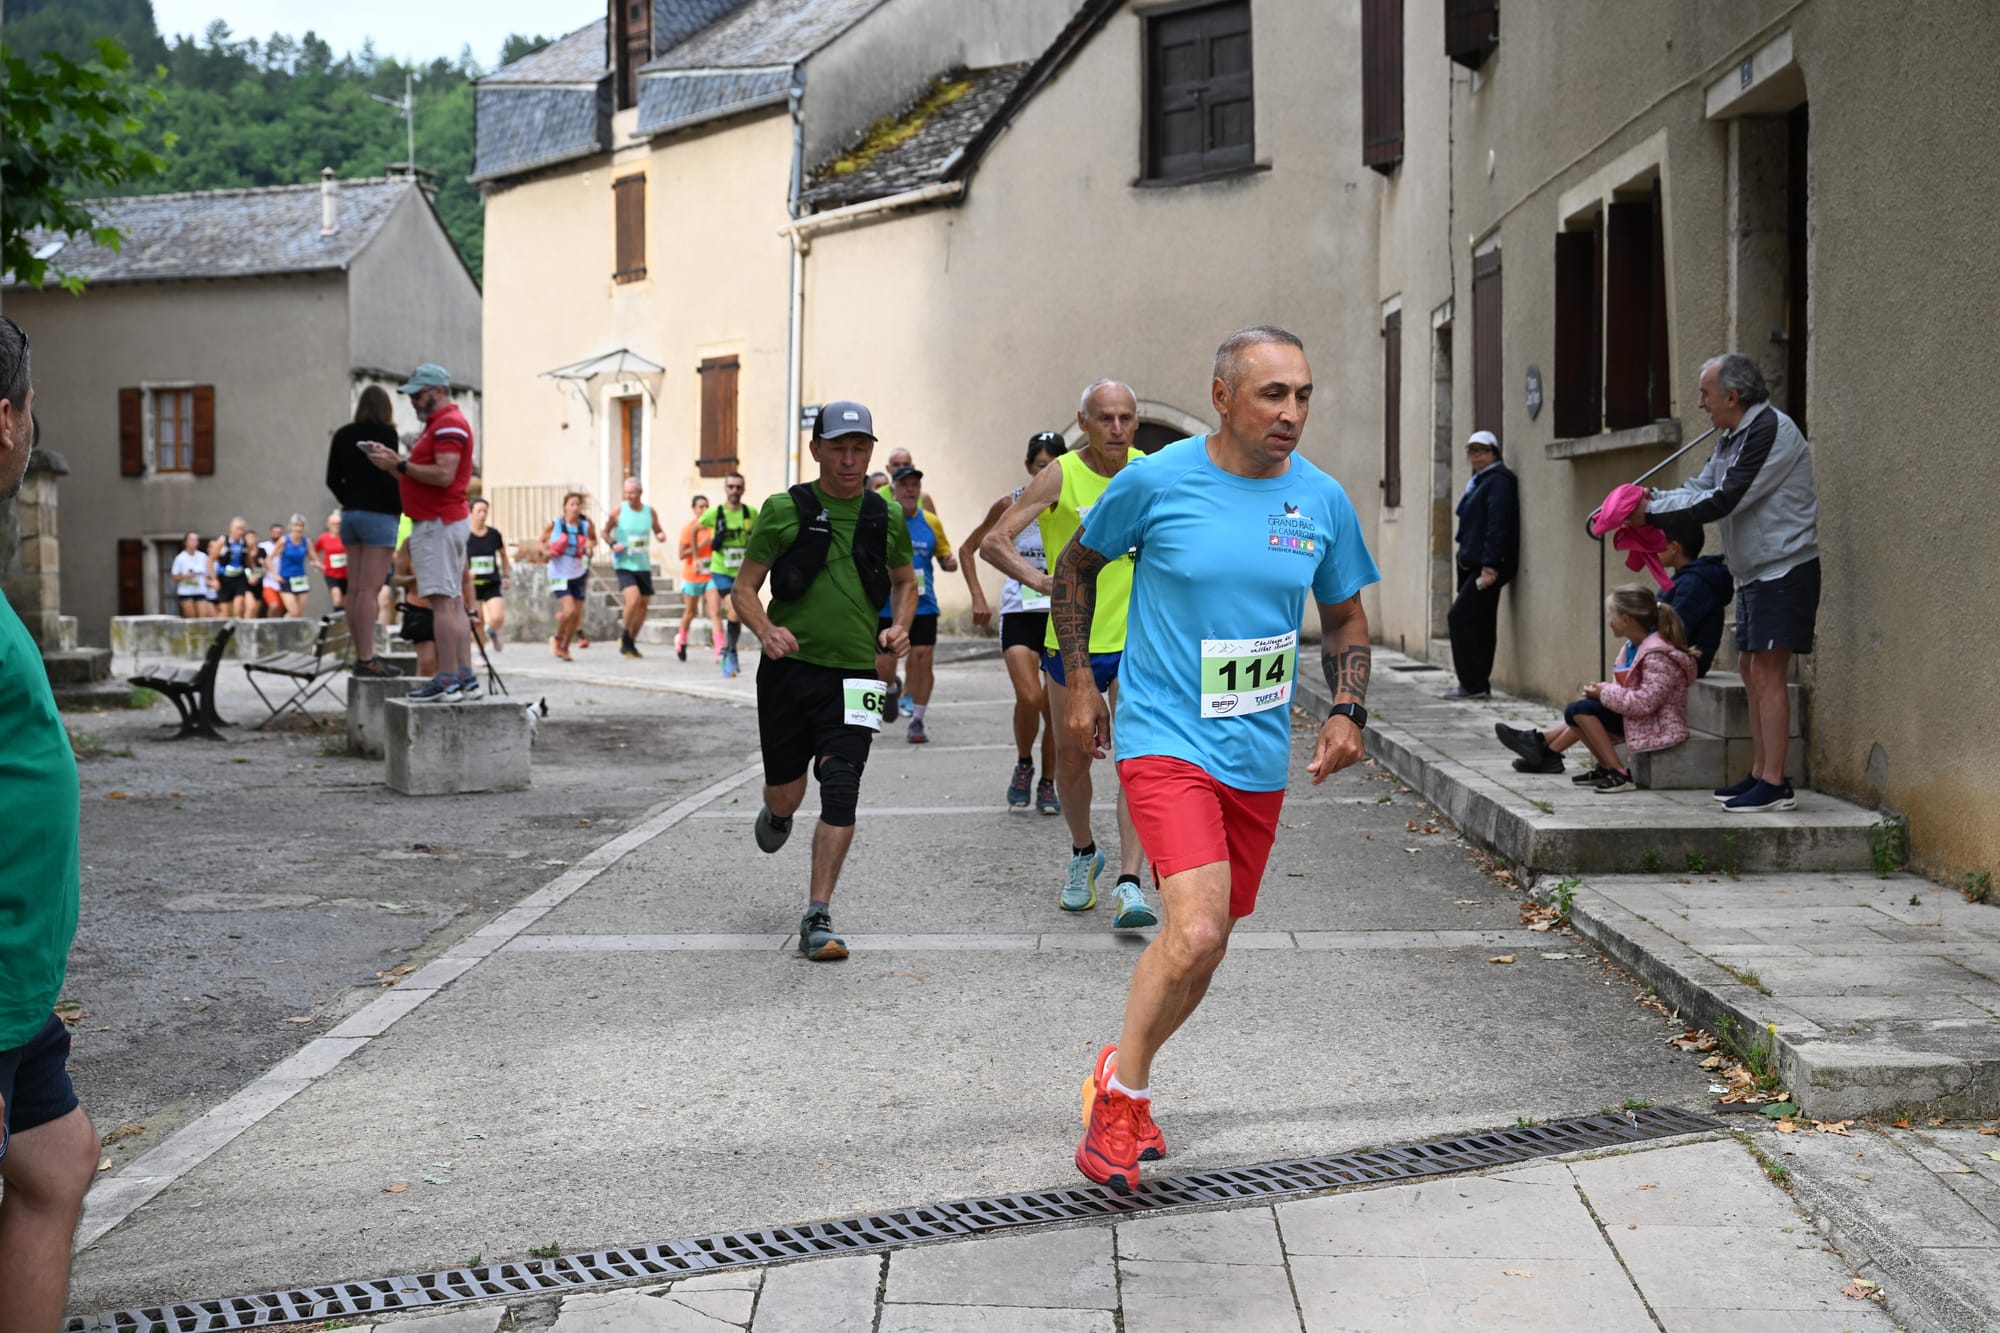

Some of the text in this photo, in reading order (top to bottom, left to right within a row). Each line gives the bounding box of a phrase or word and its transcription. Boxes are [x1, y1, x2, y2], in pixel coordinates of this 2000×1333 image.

[1268, 518, 1315, 531] GRAND RAID
[1278, 528, 1315, 540] CAMARGUE
[1292, 550, 1315, 558] MARATHON
[1219, 654, 1285, 690] 114
